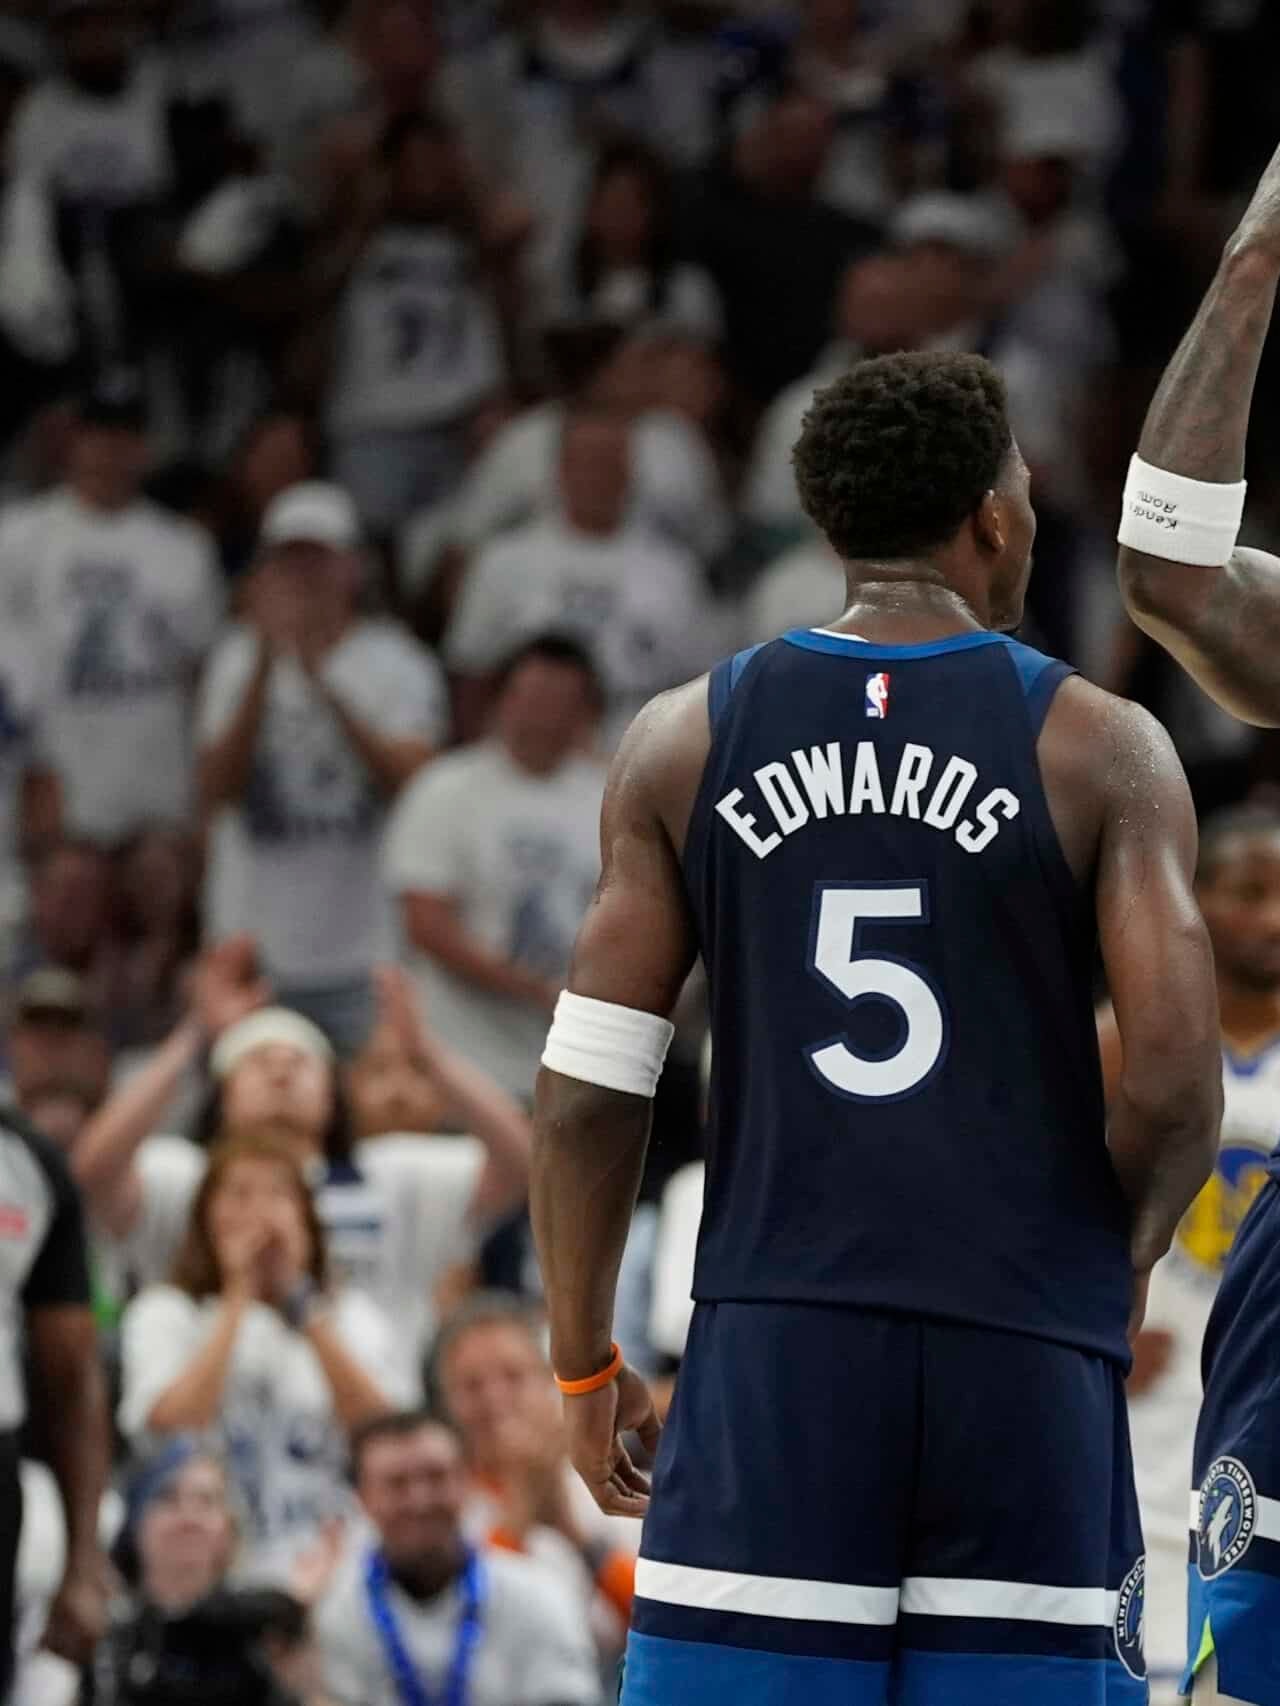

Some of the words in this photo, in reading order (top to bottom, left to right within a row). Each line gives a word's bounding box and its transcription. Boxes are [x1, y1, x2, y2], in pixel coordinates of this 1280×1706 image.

[715, 741, 1020, 859] EDWARDS
[811, 888, 943, 1096] 5
[1224, 1463, 1254, 1562] TIMBERWOLVES
